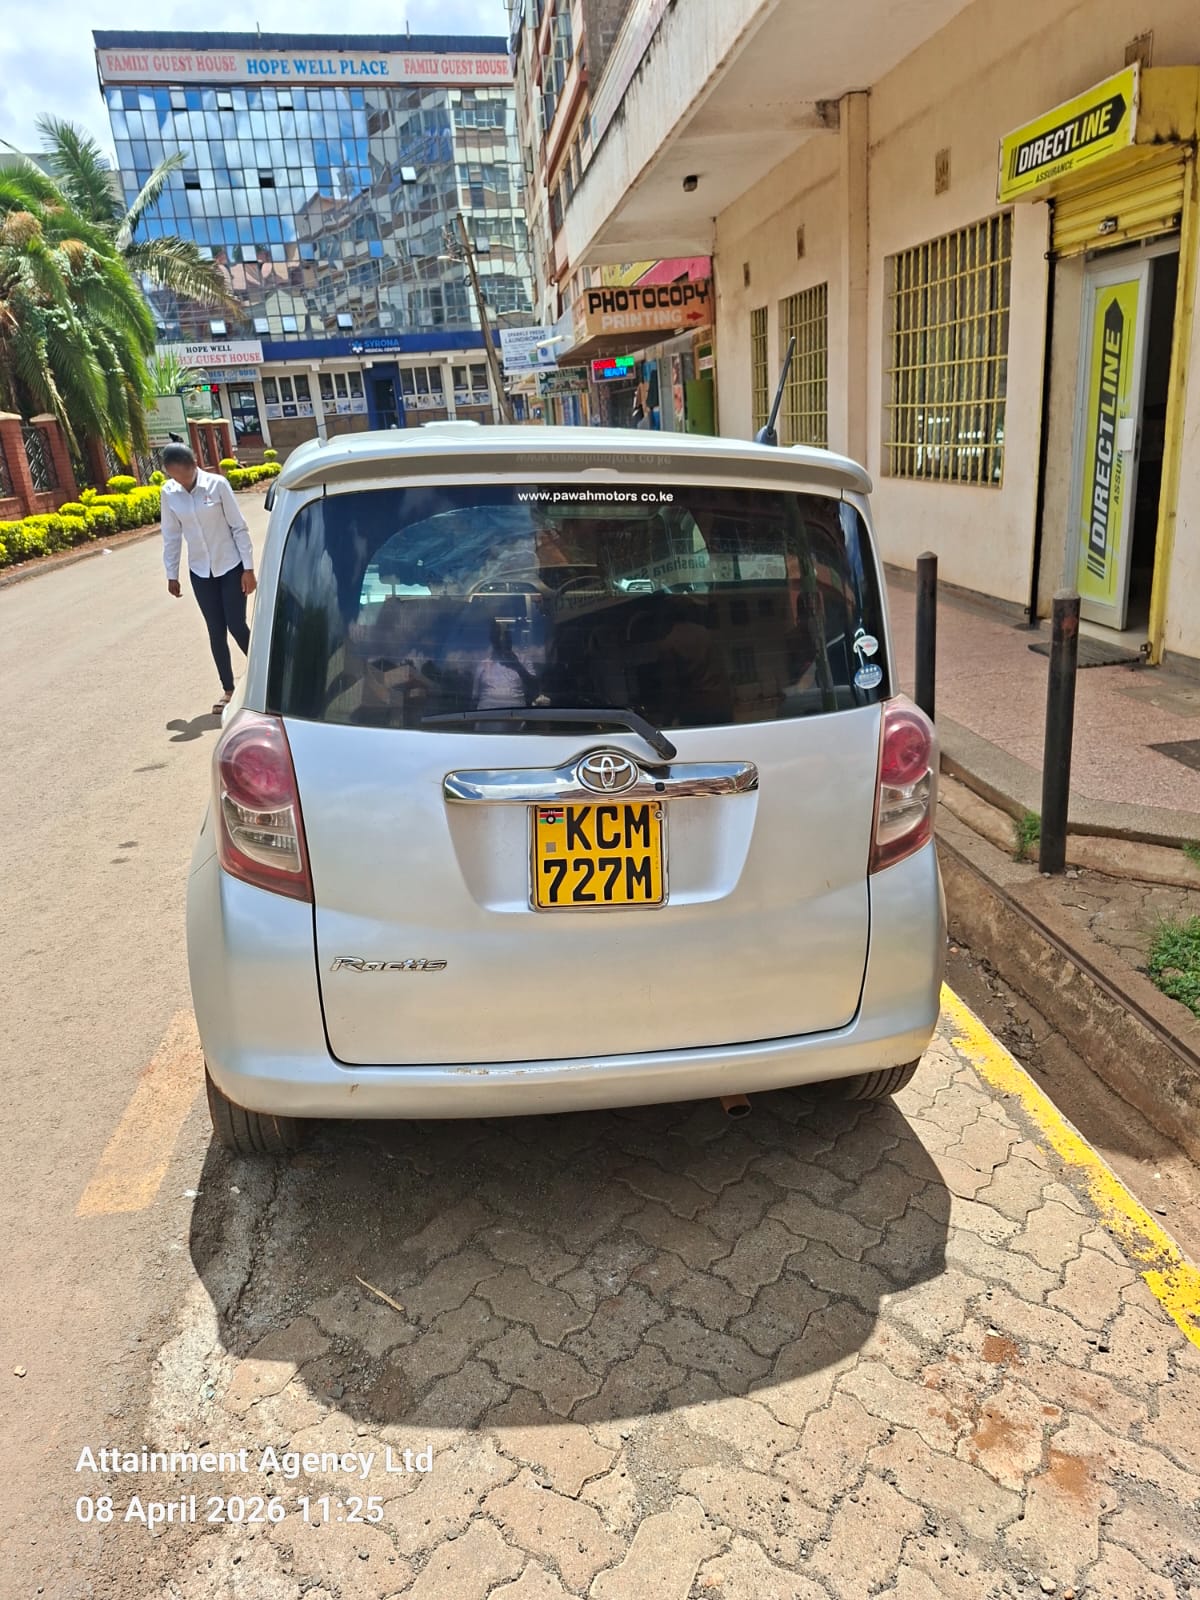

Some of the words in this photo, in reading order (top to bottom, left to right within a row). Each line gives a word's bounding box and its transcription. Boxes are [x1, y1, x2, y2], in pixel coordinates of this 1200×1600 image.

[106, 55, 149, 72] FAMILY
[152, 55, 193, 72] GUEST
[195, 55, 237, 72] HOUSE
[246, 58, 290, 74] HOPE
[293, 58, 337, 75] WELL
[339, 59, 389, 75] PLACE
[403, 58, 439, 74] FAMILY
[442, 59, 473, 75] GUEST
[475, 59, 509, 75] HOUSE
[1018, 102, 1113, 174] DIRECTLINE
[1035, 159, 1074, 183] ASSURANCE
[588, 282, 708, 315] PHOTOCOPY
[602, 310, 682, 330] PRINTING
[186, 345, 208, 354] HOPE
[364, 339, 400, 348] SYRONA
[196, 354, 228, 364] GUEST
[230, 352, 261, 363] HOUSE
[603, 367, 627, 377] BEAUTY
[1091, 328, 1121, 548] DIRECTLINE
[518, 490, 637, 503] www.pawahmotors
[641, 491, 673, 502] co.ke
[566, 804, 650, 850] KCM
[544, 856, 652, 903] 727M
[330, 956, 447, 973] Ractis
